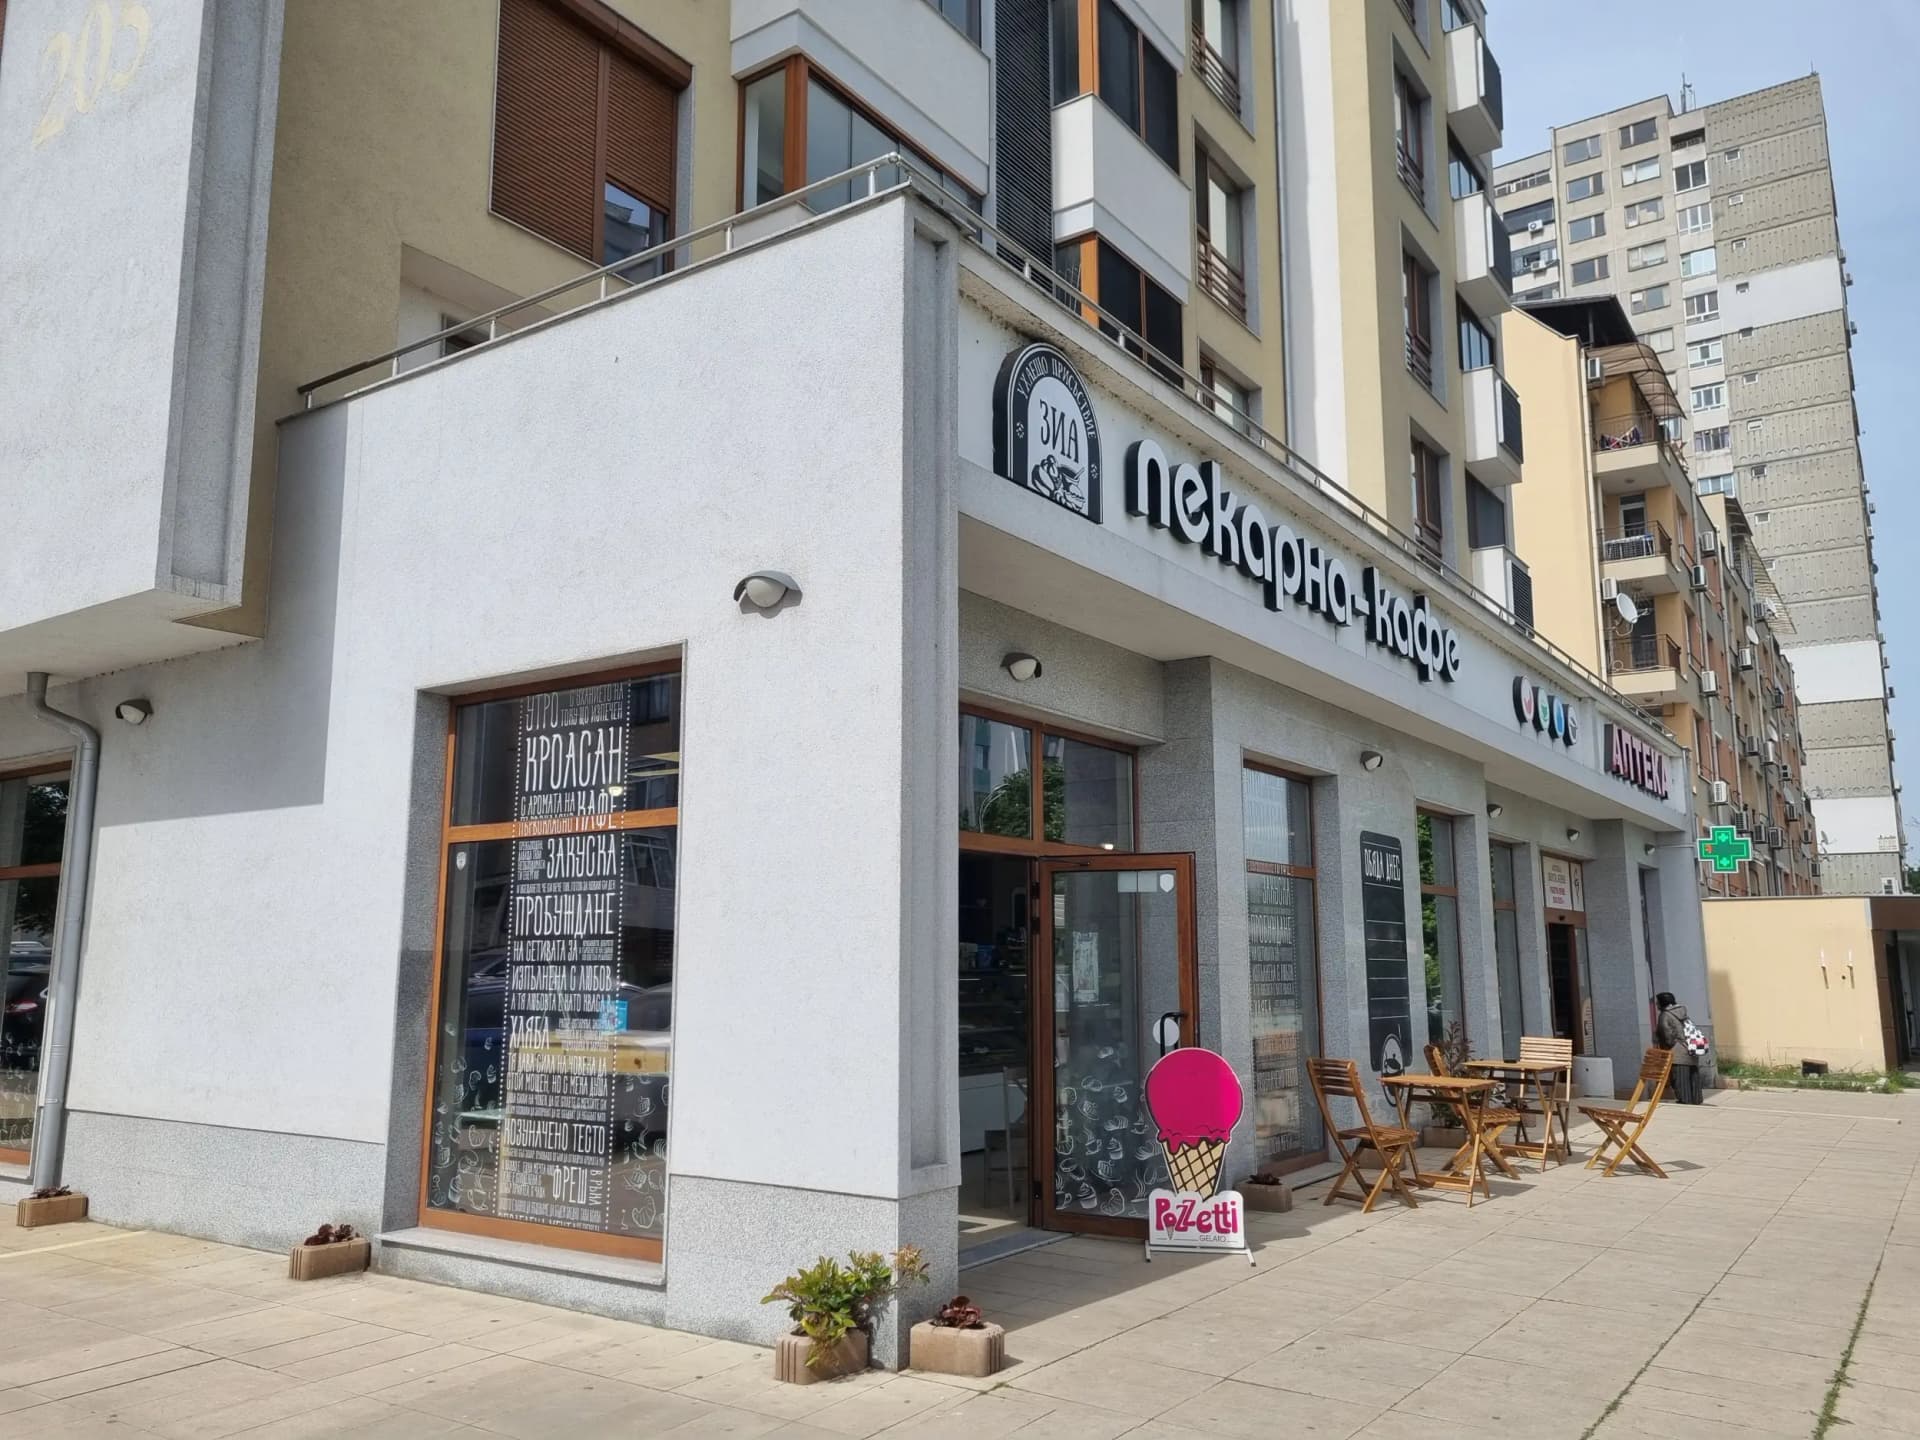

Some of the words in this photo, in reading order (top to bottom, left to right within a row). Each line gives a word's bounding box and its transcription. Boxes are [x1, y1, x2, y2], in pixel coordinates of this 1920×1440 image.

[1039, 398, 1079, 464] ЗИА
[525, 692, 559, 731] УТРО
[525, 726, 623, 792] КРОАСАН
[1611, 723, 1669, 800] АПТЕКА
[527, 793, 562, 816] АРОМАТА
[564, 791, 576, 812] НА
[575, 788, 617, 832] КАФЕ
[546, 834, 617, 879] ЗАКУСКА
[515, 892, 616, 939] ПРОБУЖДАНЕ
[513, 940, 524, 962] НА
[526, 939, 566, 962] СЕТИВАТА
[567, 939, 578, 961] ЗА
[511, 965, 567, 991] ИЗПЪЛНЕНА
[569, 965, 576, 991] С
[509, 1015, 550, 1050] ХЛЯБА
[503, 1117, 569, 1151] КОЗУНАЧЕНО
[573, 1123, 606, 1155] ТЕСТО
[552, 1165, 588, 1205] ФРЕШ
